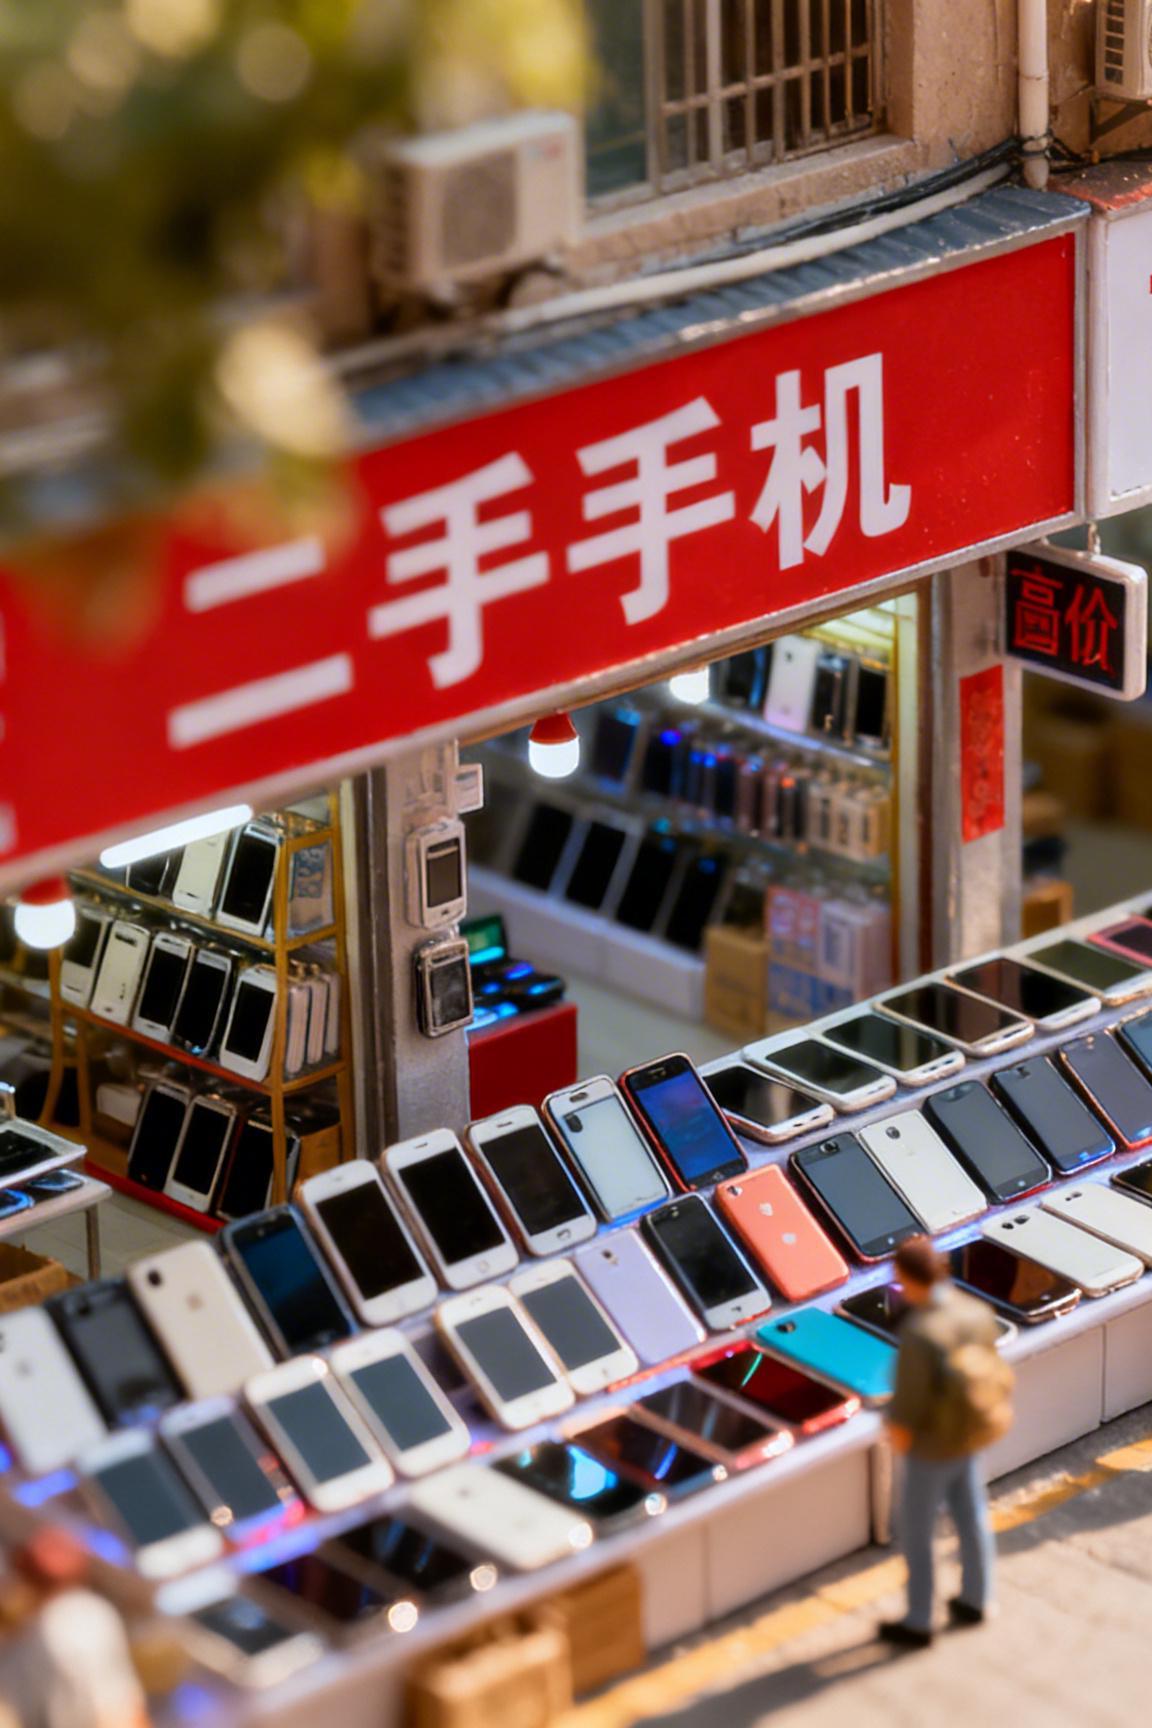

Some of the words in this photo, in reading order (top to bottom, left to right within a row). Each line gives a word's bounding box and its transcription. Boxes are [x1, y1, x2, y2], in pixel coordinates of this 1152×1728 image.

[166, 352, 914, 748] 二手手机
[1010, 563, 1119, 678] 高价
